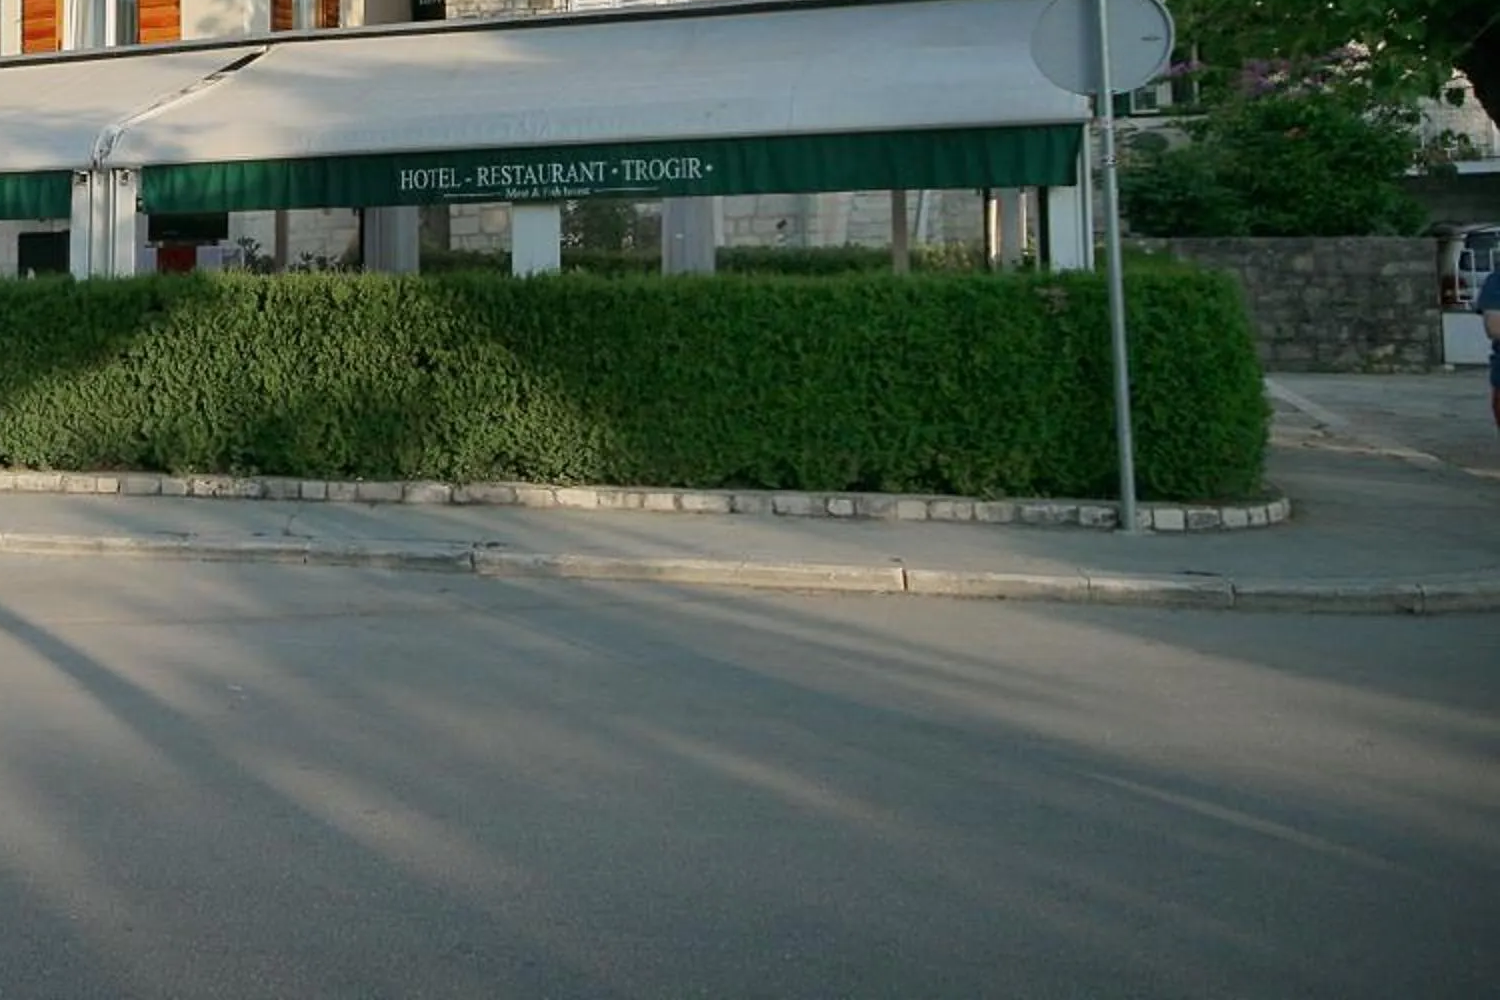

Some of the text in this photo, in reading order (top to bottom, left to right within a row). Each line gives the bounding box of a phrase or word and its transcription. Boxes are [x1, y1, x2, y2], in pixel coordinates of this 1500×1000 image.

[401, 157, 703, 190] HOTEL RESTAURANT TROGIR
